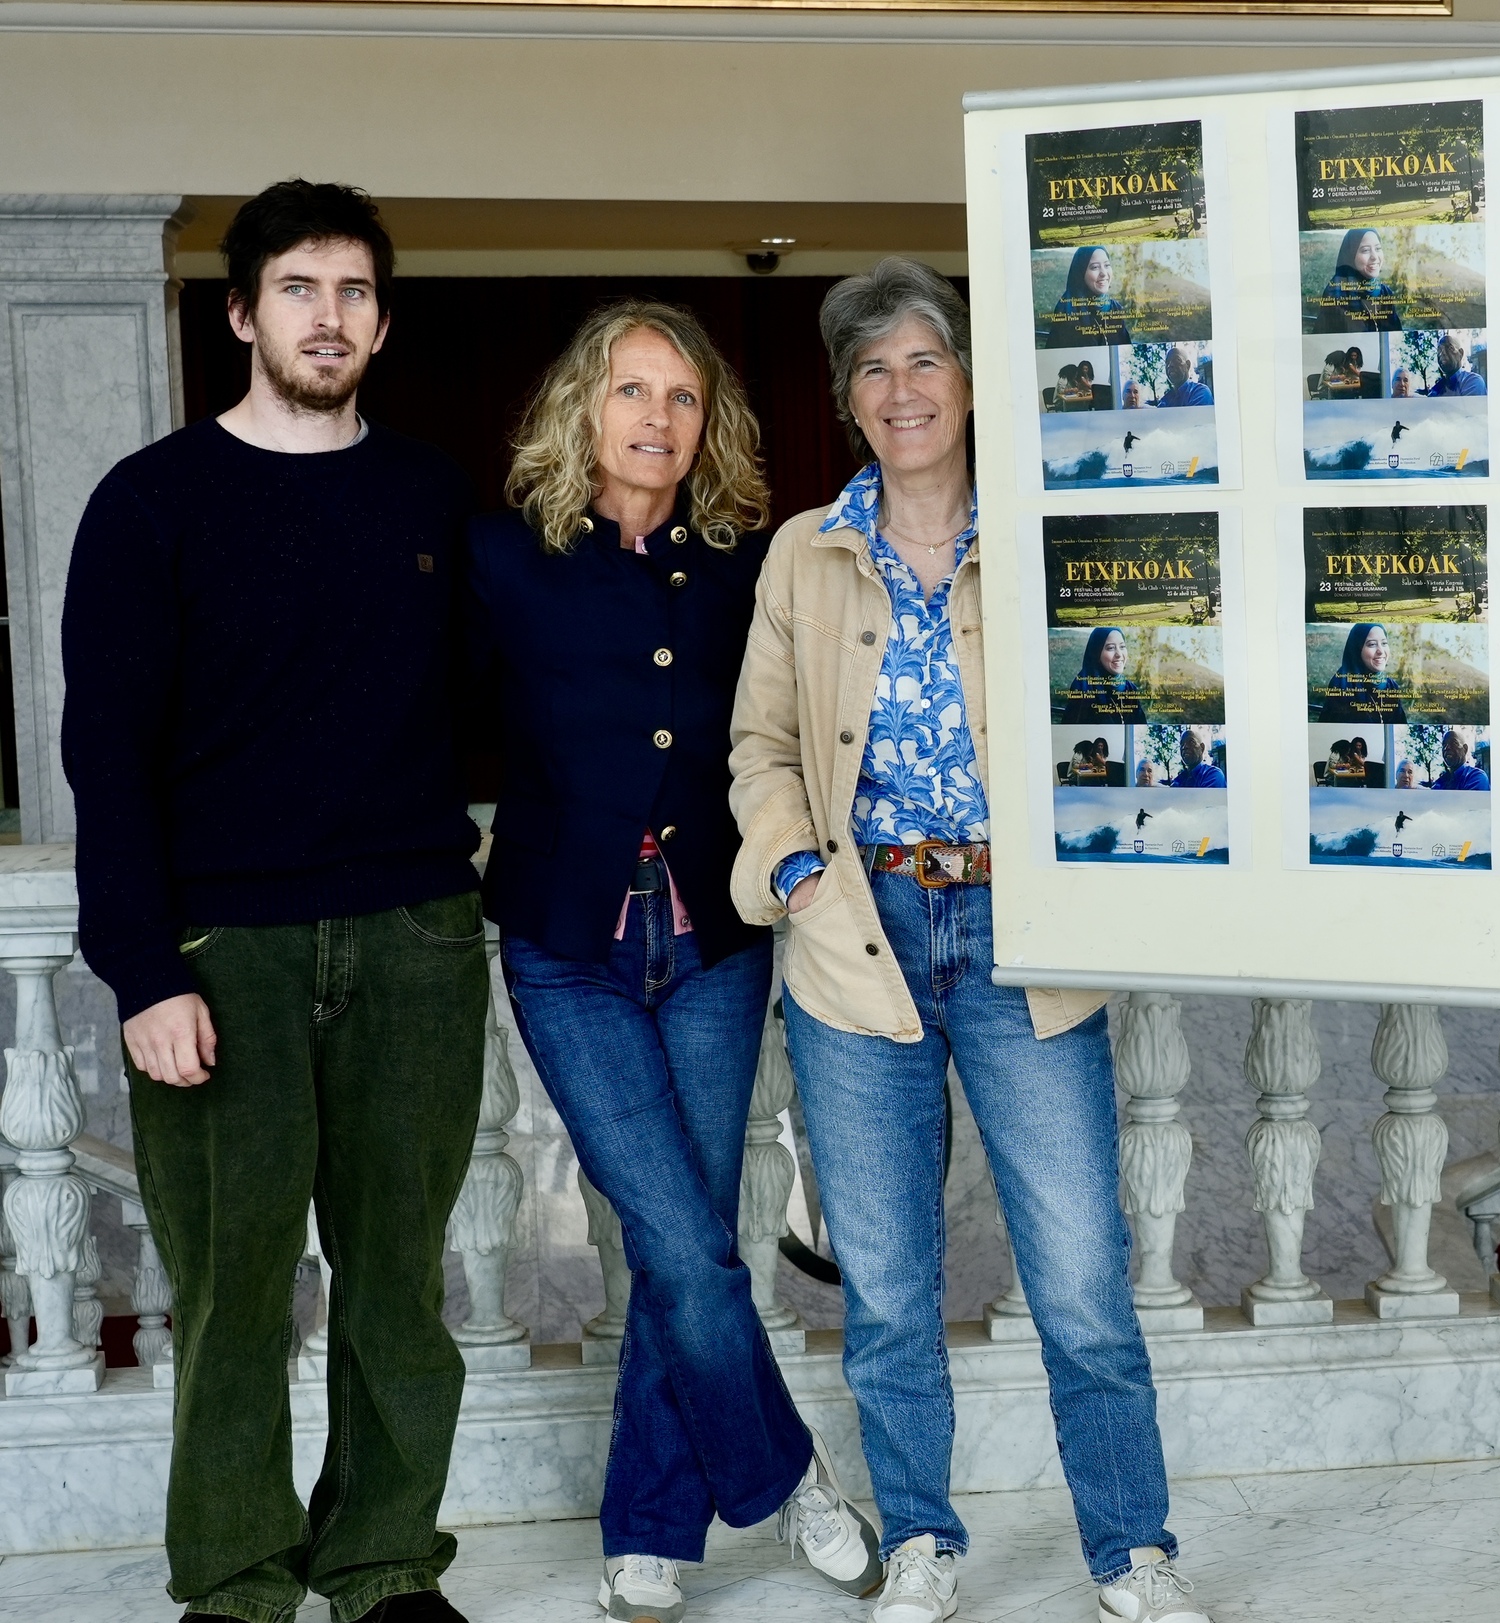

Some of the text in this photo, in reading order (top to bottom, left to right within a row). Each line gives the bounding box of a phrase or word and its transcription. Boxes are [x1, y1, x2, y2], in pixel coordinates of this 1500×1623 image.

[1319, 152, 1456, 181] ETXEKOAK
[1048, 171, 1179, 201] ETXEKOAK
[1312, 188, 1325, 198] 23
[1042, 208, 1054, 218] 23
[1066, 560, 1195, 581] ETXEKOAK
[1326, 554, 1461, 575] ETXEKOAK
[1059, 588, 1071, 598] 23
[1319, 582, 1331, 592] 23
